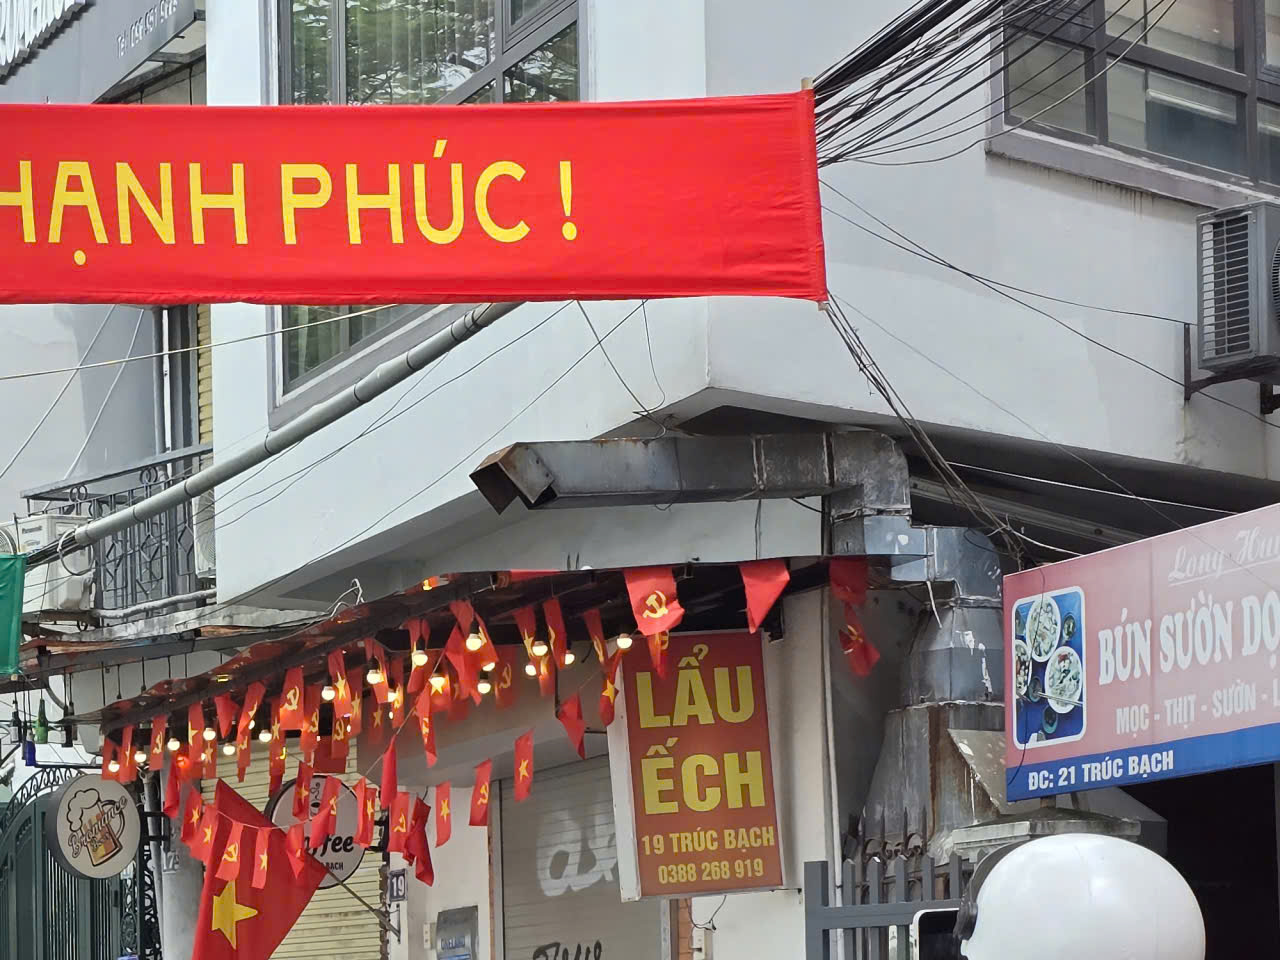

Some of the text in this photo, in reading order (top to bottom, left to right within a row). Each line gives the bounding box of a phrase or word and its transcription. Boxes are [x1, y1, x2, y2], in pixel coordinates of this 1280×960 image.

[281, 140, 531, 245] PHÚC
[559, 160, 578, 241] !
[1168, 545, 1224, 581] Long
[1099, 608, 1151, 685] BÚN
[1160, 590, 1233, 672] SƯỜN
[636, 644, 754, 728] LẨU
[1116, 704, 1150, 738] MỌC
[1165, 695, 1196, 729] THỊT
[1212, 679, 1256, 718] SƯỜN
[641, 737, 766, 815] ẾCH
[1028, 750, 1174, 791] ĐC: 21 TRÚC BẠCH
[68, 795, 127, 858] Bromance
[642, 826, 775, 855] 19 TRÚC BẠCH
[391, 876, 405, 898] 19
[658, 858, 764, 884] 0388 268 919
